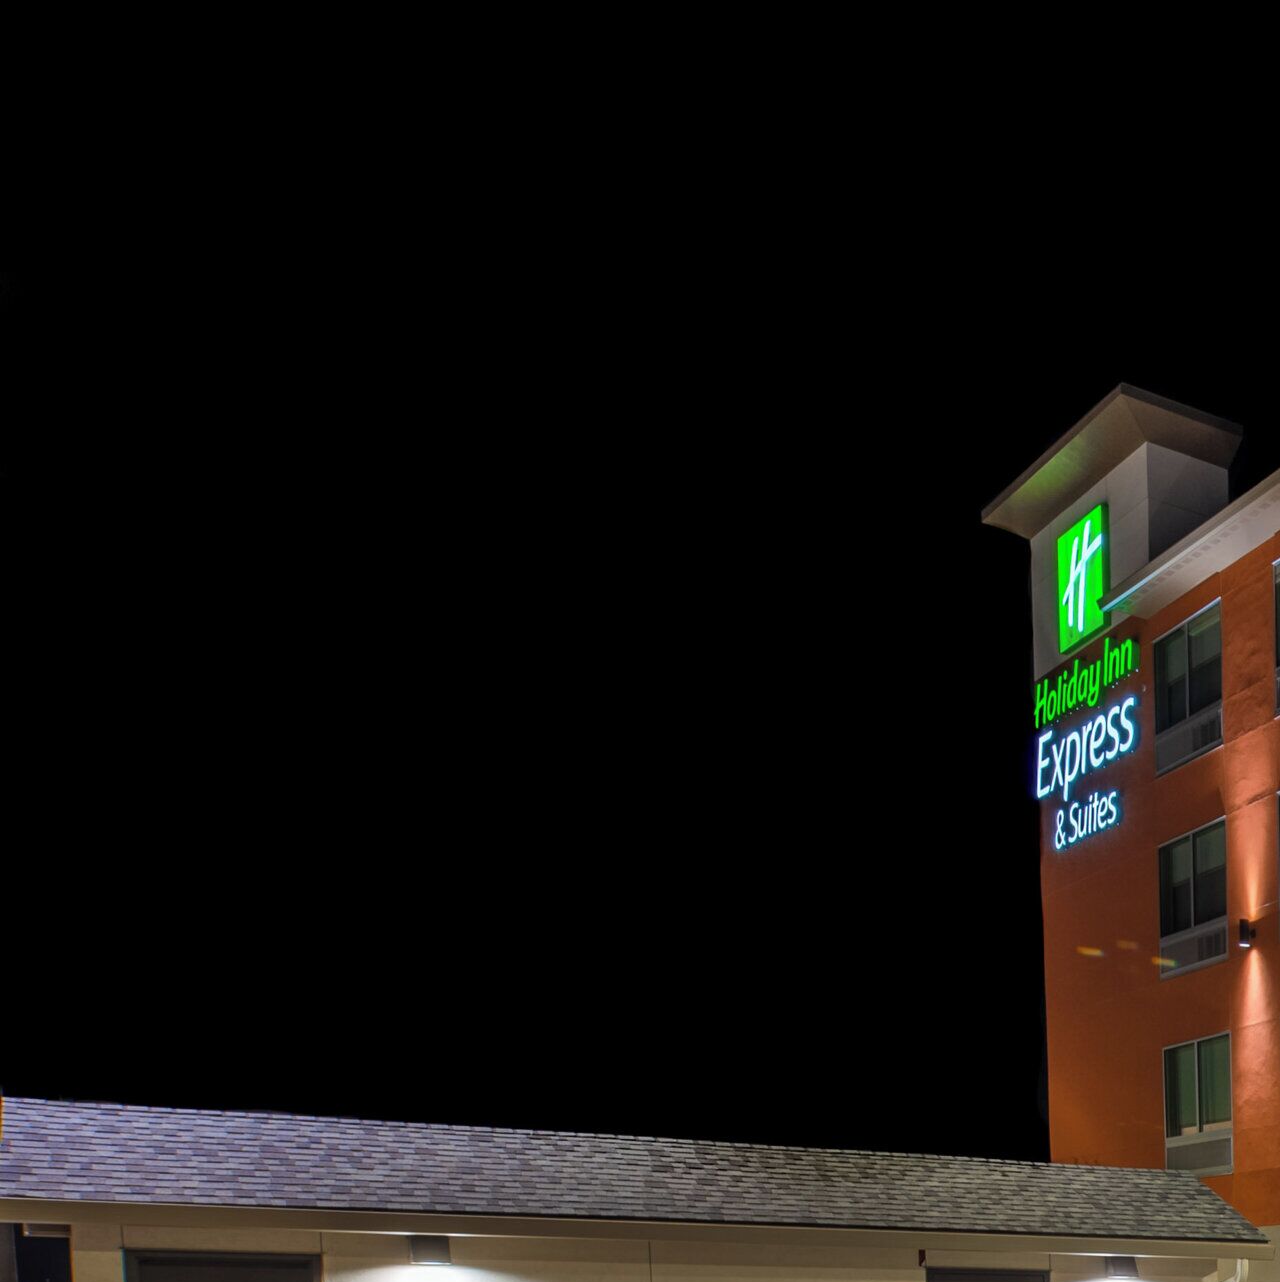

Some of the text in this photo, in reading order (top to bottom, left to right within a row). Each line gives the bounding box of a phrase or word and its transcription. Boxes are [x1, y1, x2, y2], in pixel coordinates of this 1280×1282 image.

[1034, 637, 1132, 729] Holiday Inn
[1037, 697, 1135, 802] Express
[1055, 791, 1117, 849] & Suites
